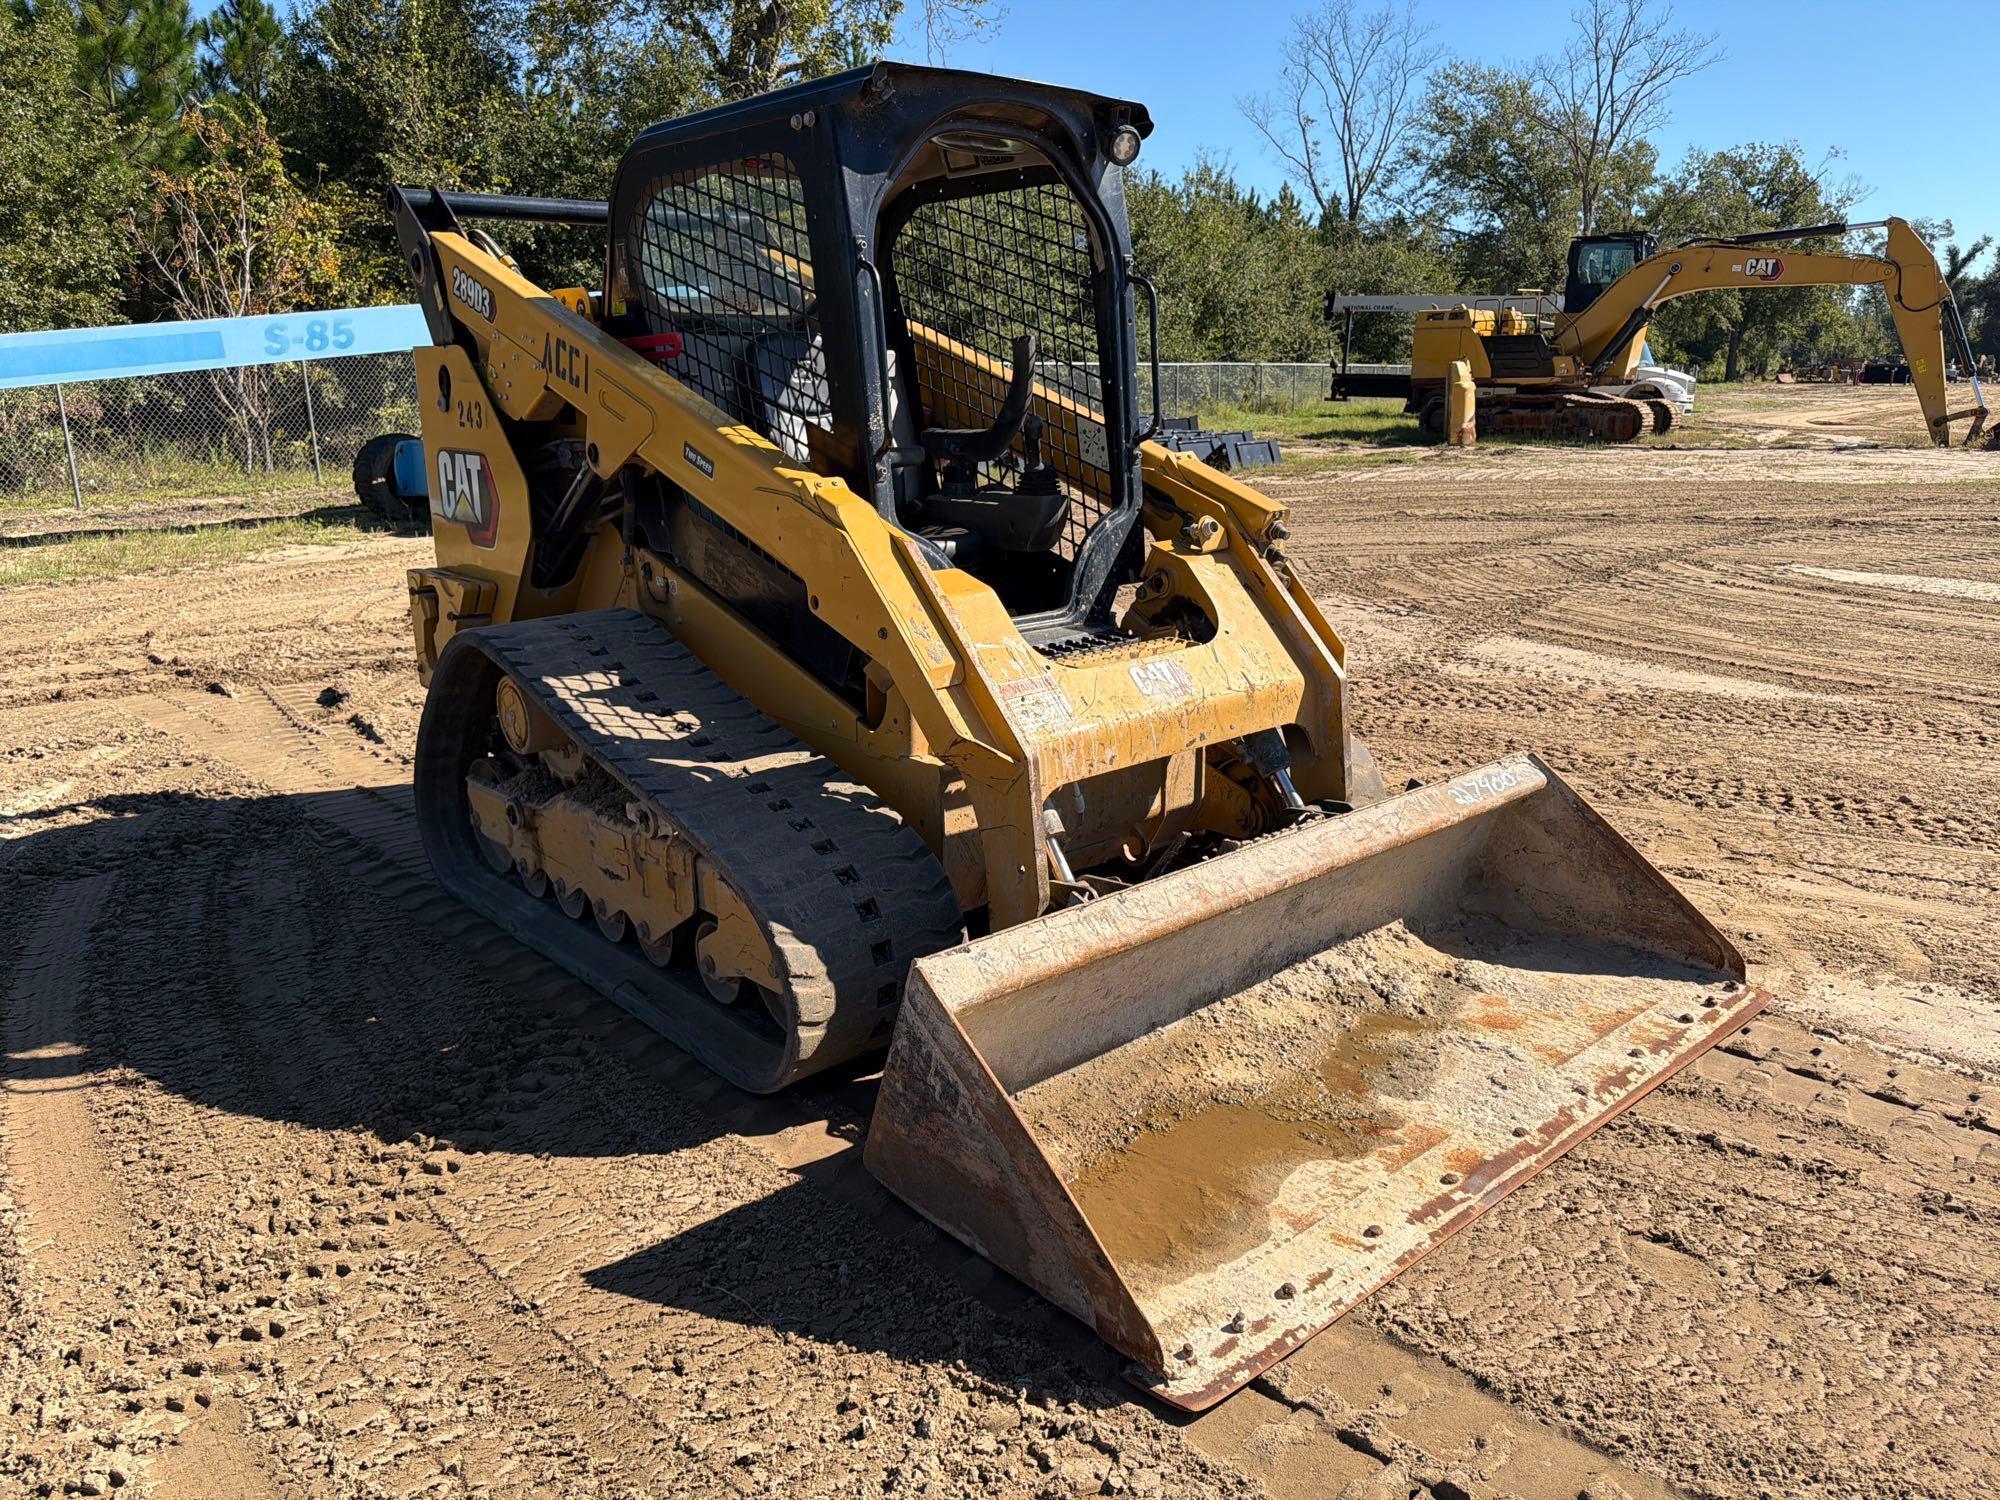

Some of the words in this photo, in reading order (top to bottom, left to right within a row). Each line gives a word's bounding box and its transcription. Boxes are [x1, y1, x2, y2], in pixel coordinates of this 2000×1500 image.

[1745, 258, 1777, 276] CAT
[452, 267, 491, 320] 289D3
[264, 318, 355, 356] S-85
[437, 450, 482, 524] CAT
[1128, 660, 1182, 697] CAT
